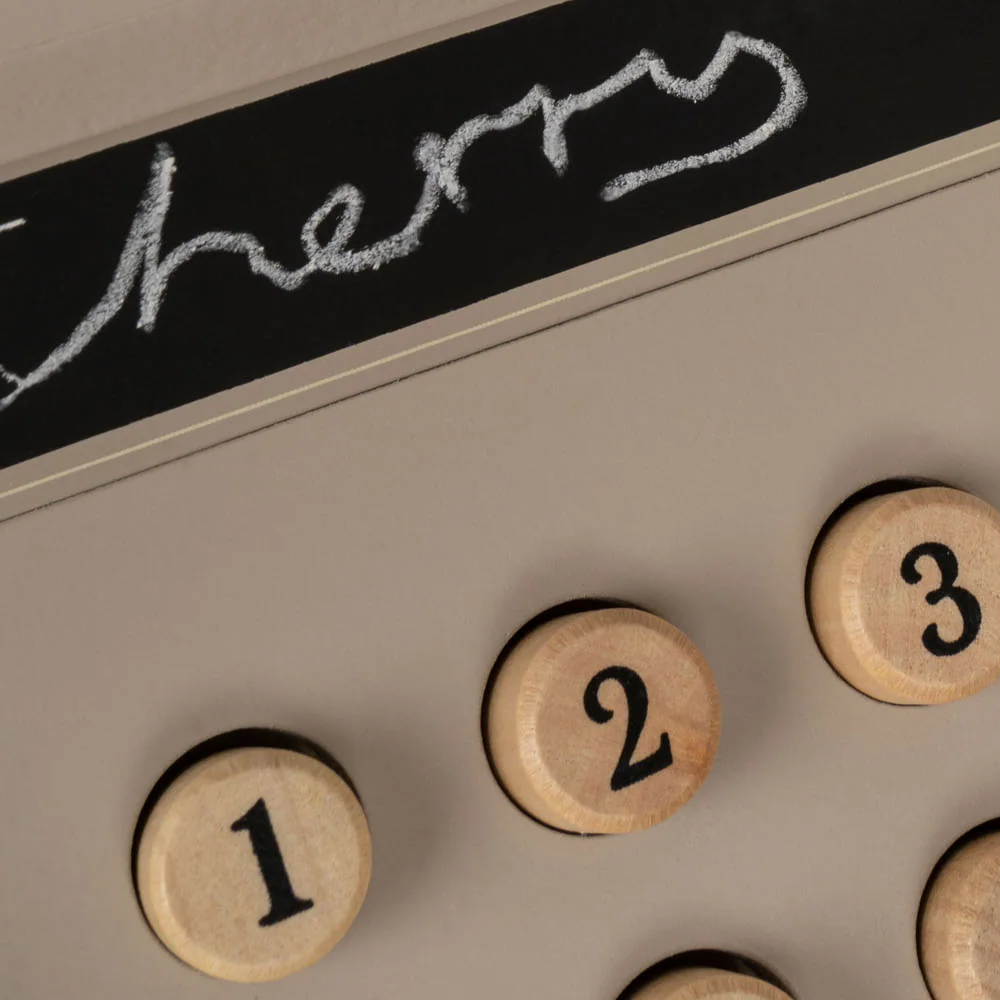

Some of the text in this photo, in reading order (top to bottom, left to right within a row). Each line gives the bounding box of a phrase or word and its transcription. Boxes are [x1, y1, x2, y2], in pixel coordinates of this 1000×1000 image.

[0, 30, 808, 410] herry
[900, 542, 982, 657] 3
[583, 666, 673, 792] 2
[231, 798, 314, 927] 1
